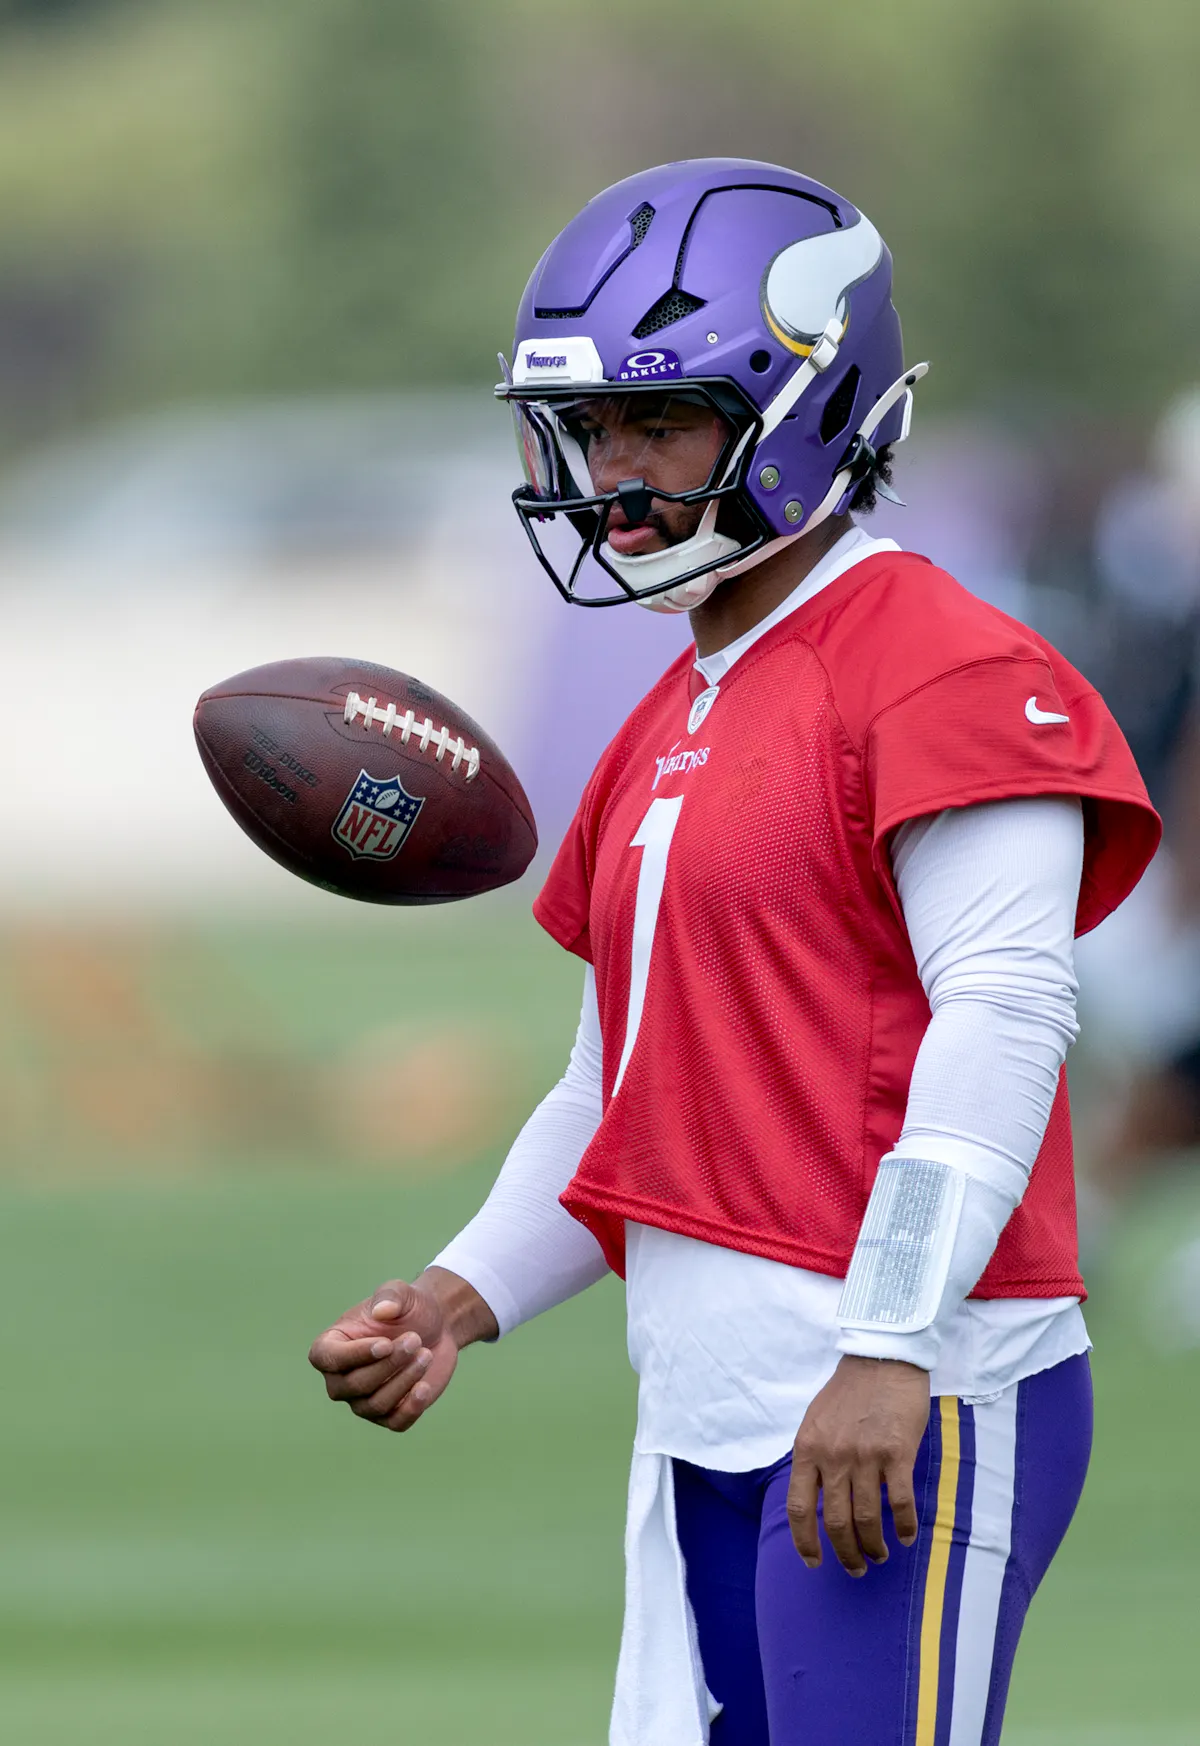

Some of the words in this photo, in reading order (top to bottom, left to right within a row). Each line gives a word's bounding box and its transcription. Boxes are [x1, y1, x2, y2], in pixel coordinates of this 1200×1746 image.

[620, 361, 677, 380] OAKLEY
[339, 804, 398, 853] NFL
[629, 794, 684, 1098] 1
